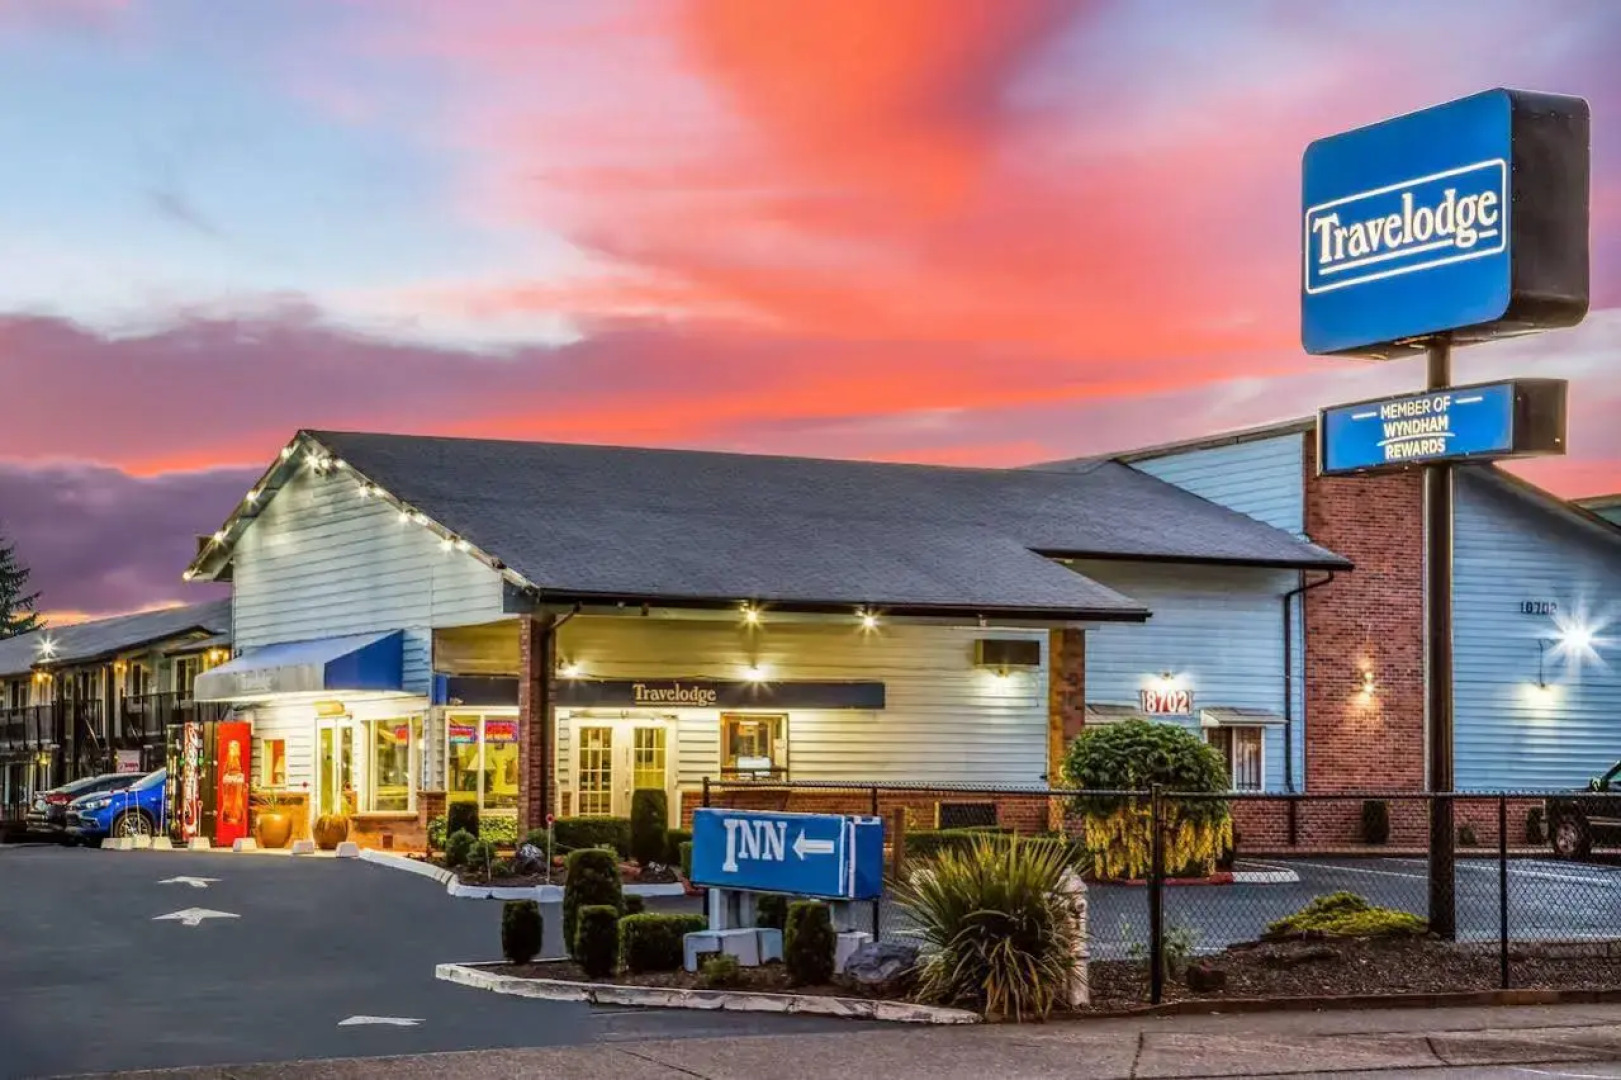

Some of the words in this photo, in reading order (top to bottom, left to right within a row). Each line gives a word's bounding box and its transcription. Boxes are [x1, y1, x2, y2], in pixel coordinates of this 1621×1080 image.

[1313, 188, 1498, 264] Travelodge
[1381, 399, 1431, 420] MEMBER
[1433, 396, 1451, 413] OF
[1384, 414, 1449, 438] WYNDHAM
[1385, 438, 1446, 460] REWARDS
[632, 682, 717, 707] Travelodge
[1146, 689, 1189, 713] 8702
[722, 818, 787, 872] INN
